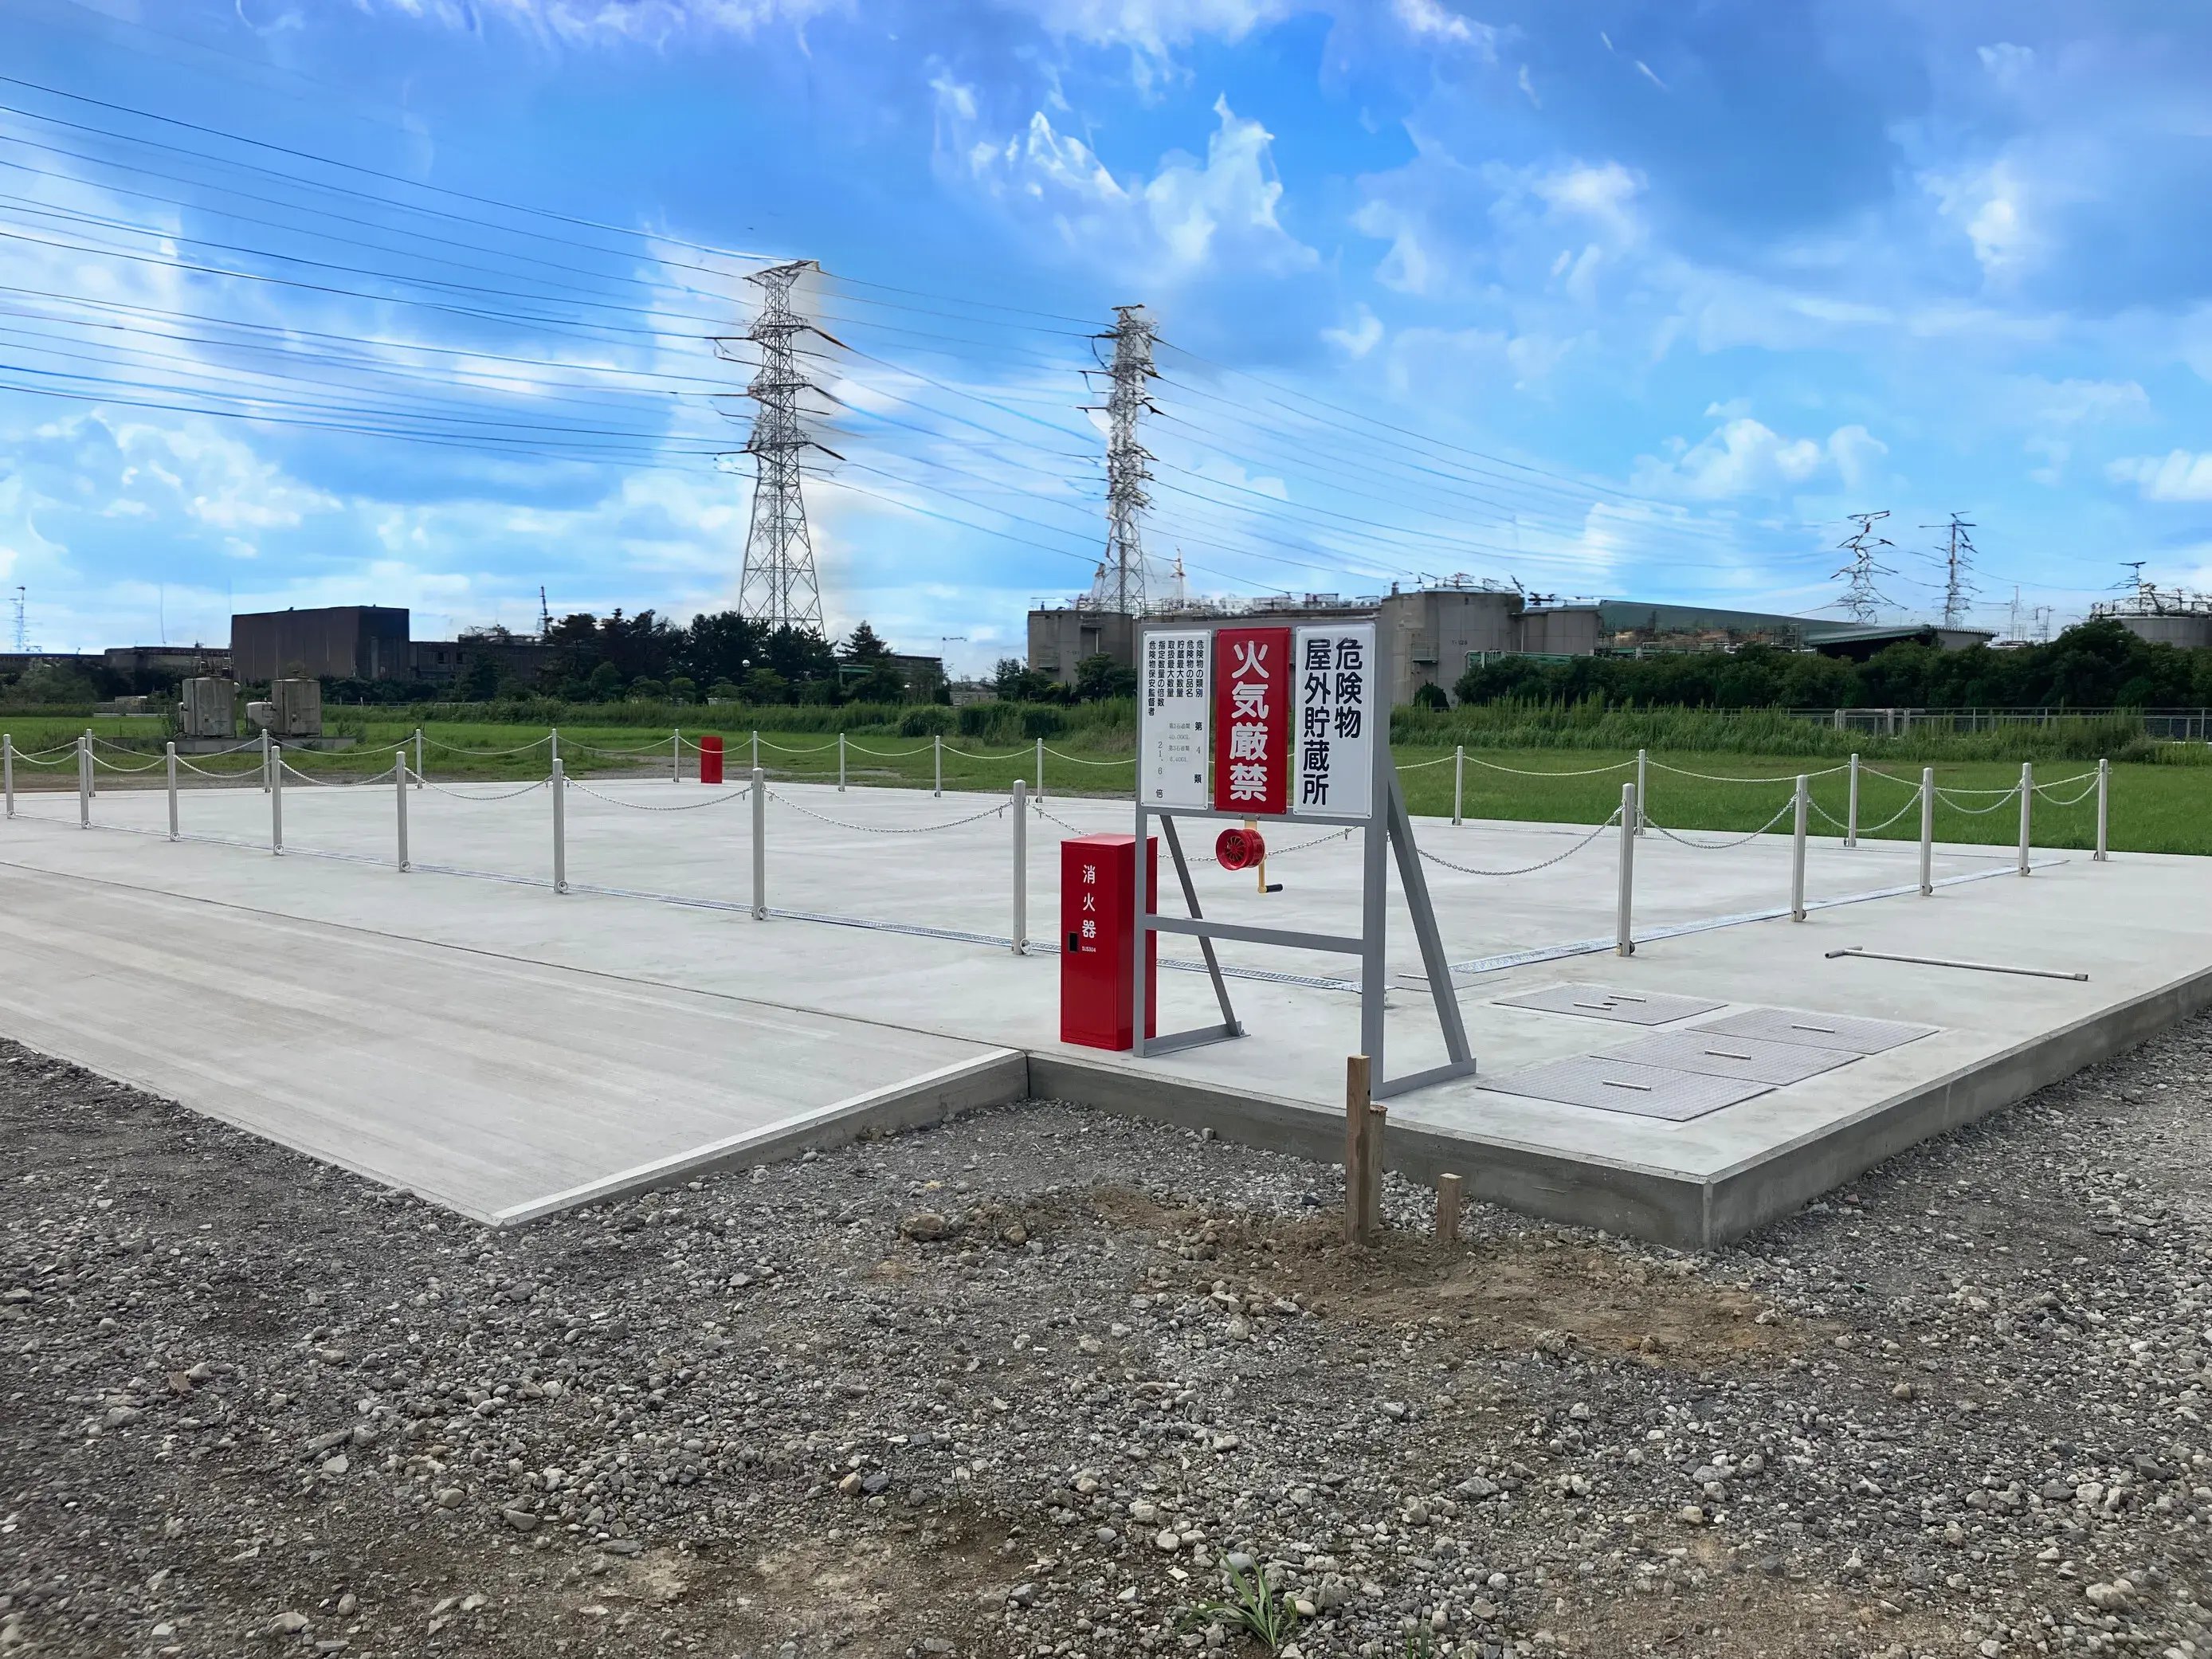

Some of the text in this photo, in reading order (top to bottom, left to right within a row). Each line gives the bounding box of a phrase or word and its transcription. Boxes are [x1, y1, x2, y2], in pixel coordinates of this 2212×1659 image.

[1147, 641, 1156, 716] 危険物保安監督者
[1157, 641, 1166, 707] 指定数量の倍数
[1167, 640, 1175, 698] 取扱最大数量
[1176, 640, 1185, 698] 貯蔵最大数量
[1186, 640, 1194, 698] 危険物の品名
[1195, 640, 1204, 698] 危険物の類別
[1334, 637, 1363, 739] 危険物
[1229, 640, 1271, 802] 火気厳禁
[1302, 638, 1332, 806] 屋外貯蔵所
[1081, 865, 1096, 939] 消火器
